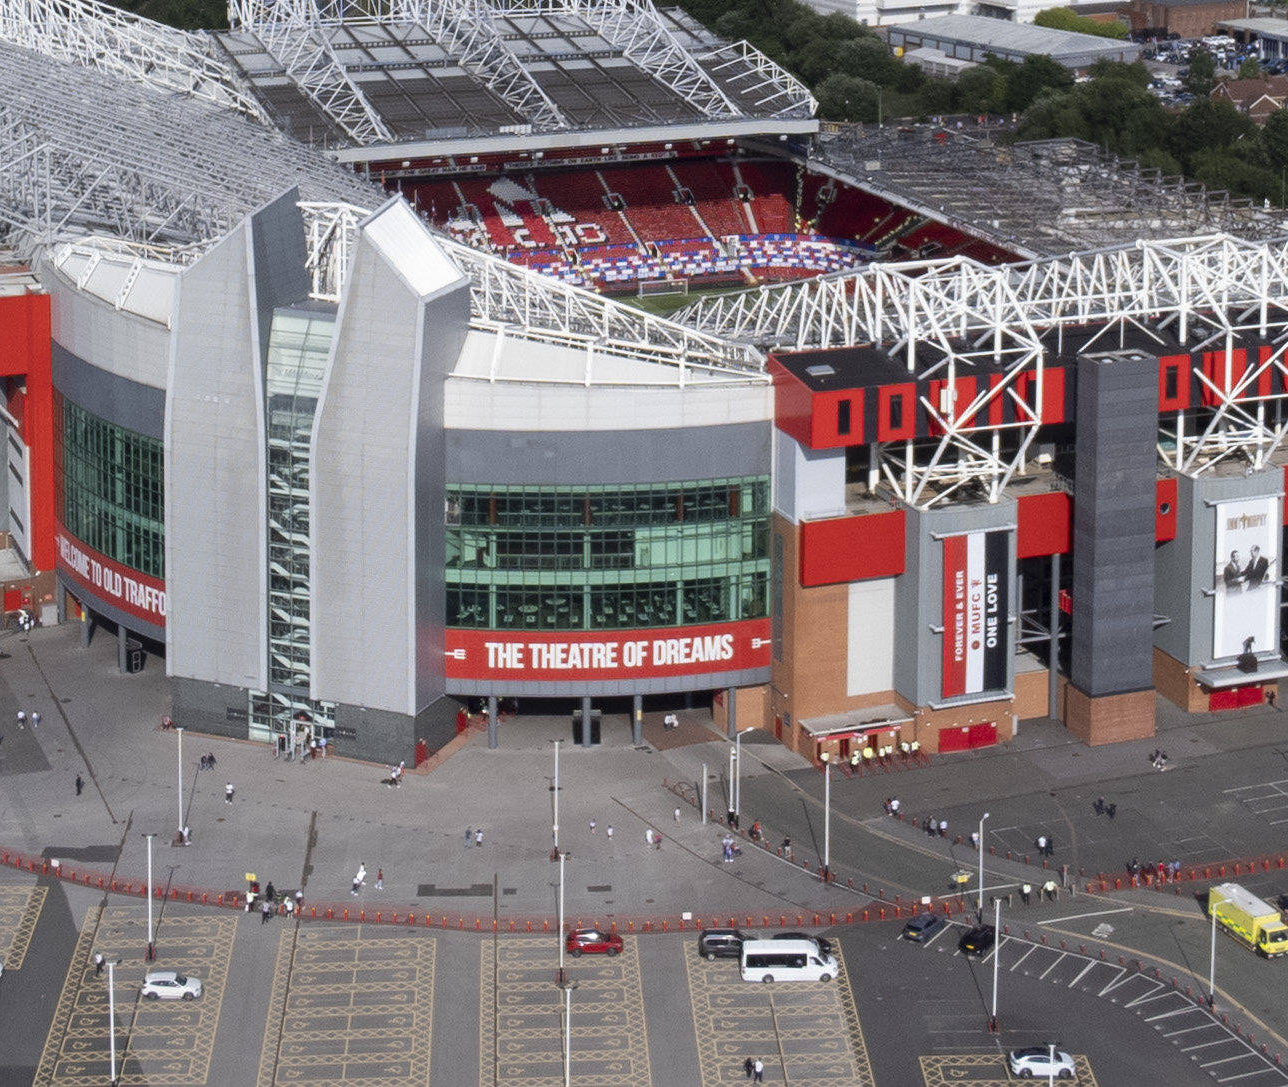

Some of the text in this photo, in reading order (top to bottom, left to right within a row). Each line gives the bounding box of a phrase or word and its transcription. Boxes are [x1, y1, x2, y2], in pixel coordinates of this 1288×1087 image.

[91, 559, 102, 587] TO
[103, 567, 122, 598] OLD
[955, 570, 964, 600] EVER
[972, 593, 981, 634] MUFC
[986, 573, 998, 648] ONE LOVE
[485, 634, 734, 670] THE THEATRE OF DREAMS
[955, 612, 964, 662] FOREVER
